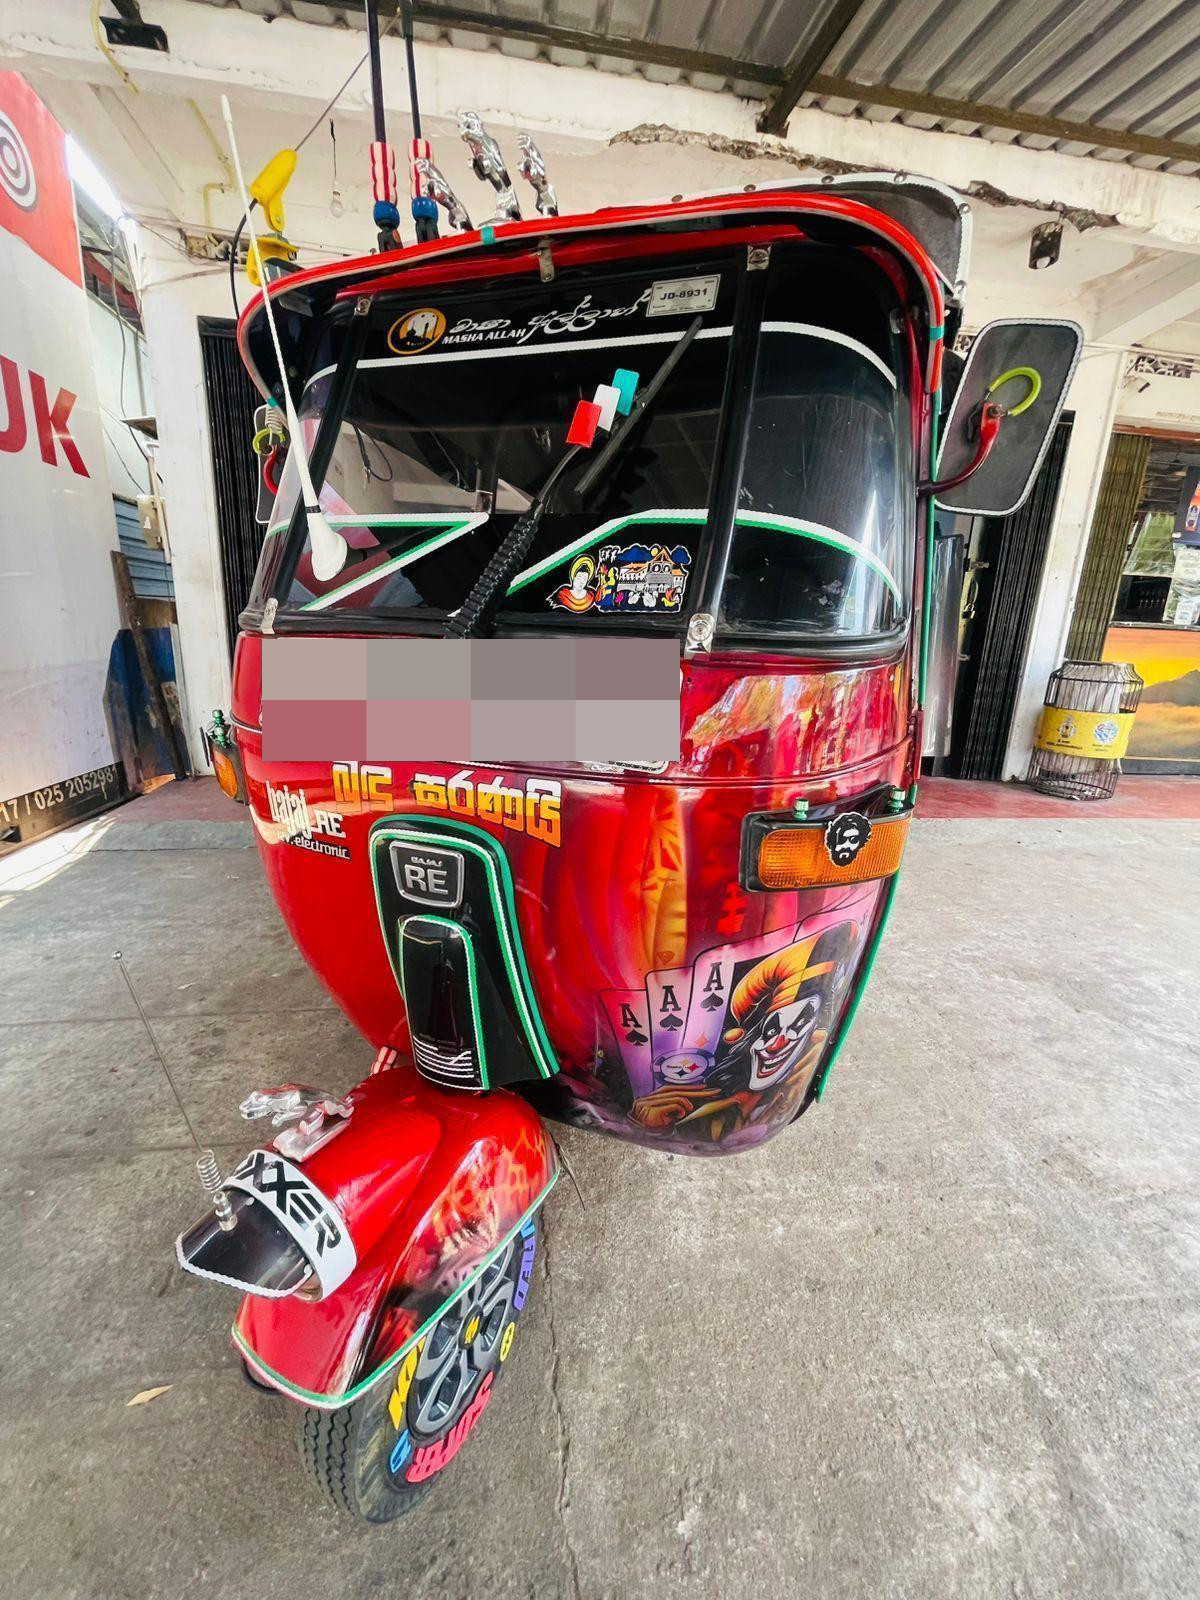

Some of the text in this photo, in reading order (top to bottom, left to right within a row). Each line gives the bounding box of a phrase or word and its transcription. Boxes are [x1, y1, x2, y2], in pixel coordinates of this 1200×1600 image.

[660, 288, 708, 301] JD-8931
[442, 328, 526, 345] MASHA ALLAH
[34, 784, 64, 810] 025
[313, 809, 346, 838] RE
[405, 864, 448, 894] RE
[703, 962, 724, 992] A
[659, 985, 681, 1012] A
[620, 1003, 642, 1028] A
